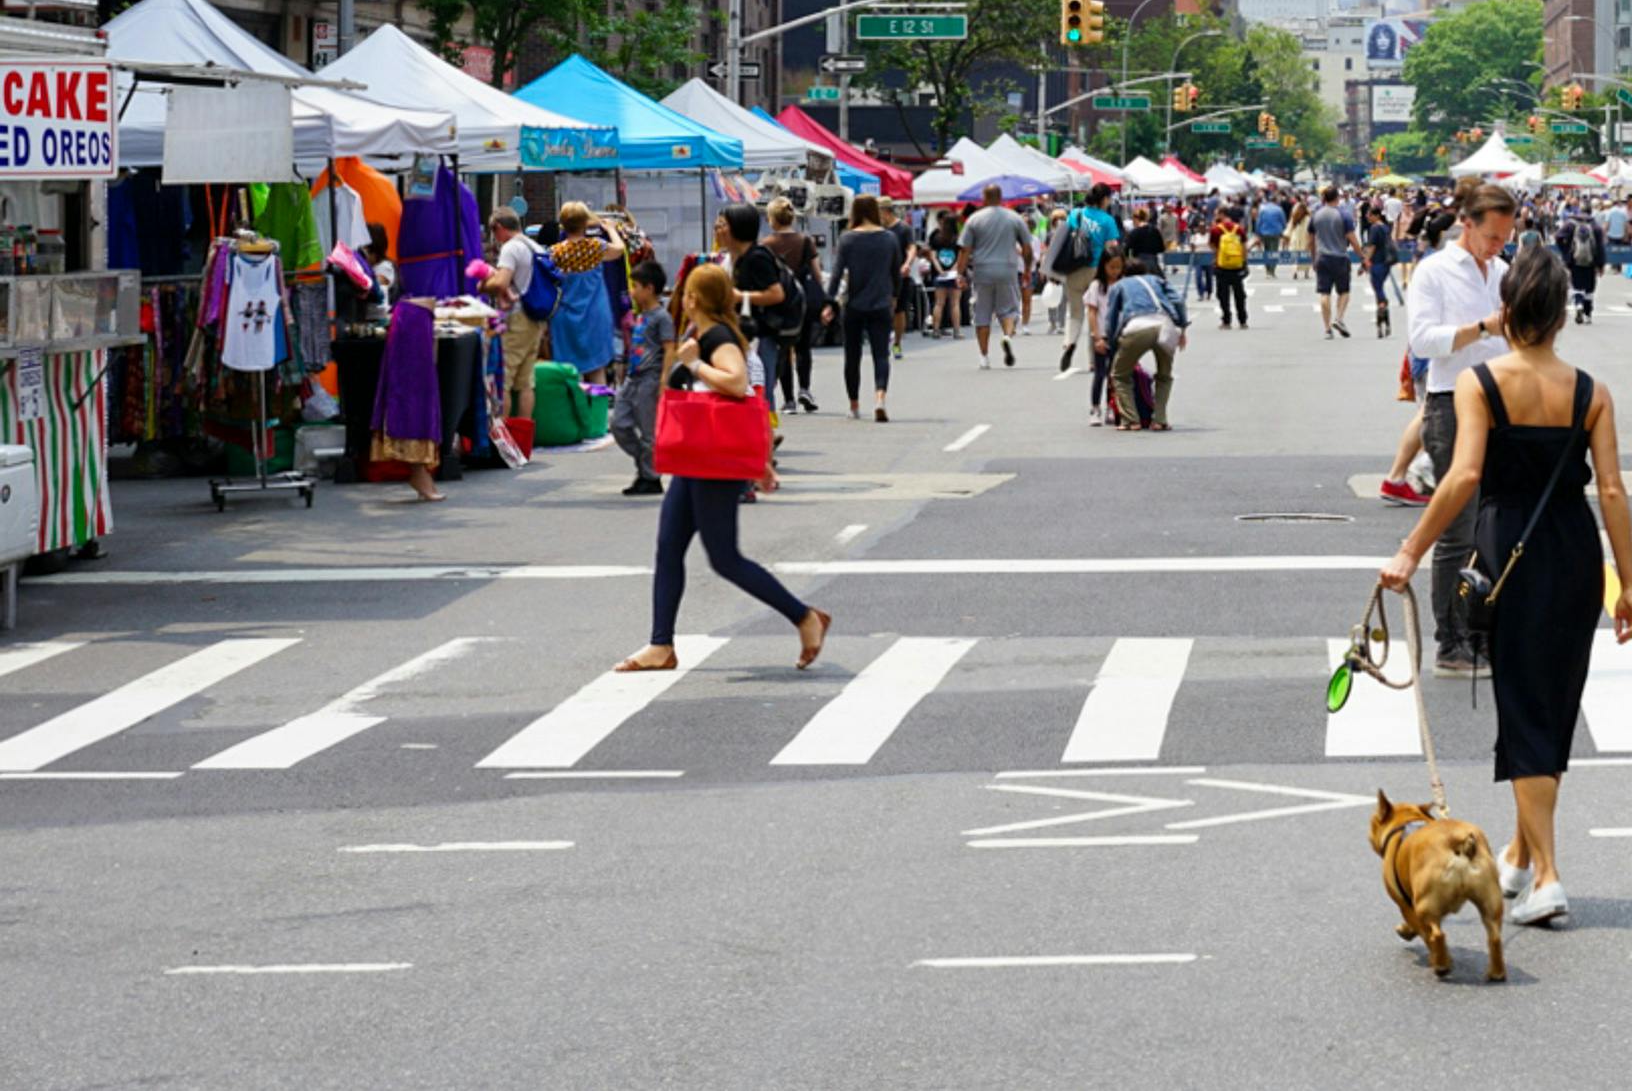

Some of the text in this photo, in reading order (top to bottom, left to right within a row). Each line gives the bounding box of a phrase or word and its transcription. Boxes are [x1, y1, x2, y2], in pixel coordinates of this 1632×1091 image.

[889, 20, 935, 34] E 12 St
[3, 70, 108, 123] CAKE
[42, 127, 111, 167] OREOS
